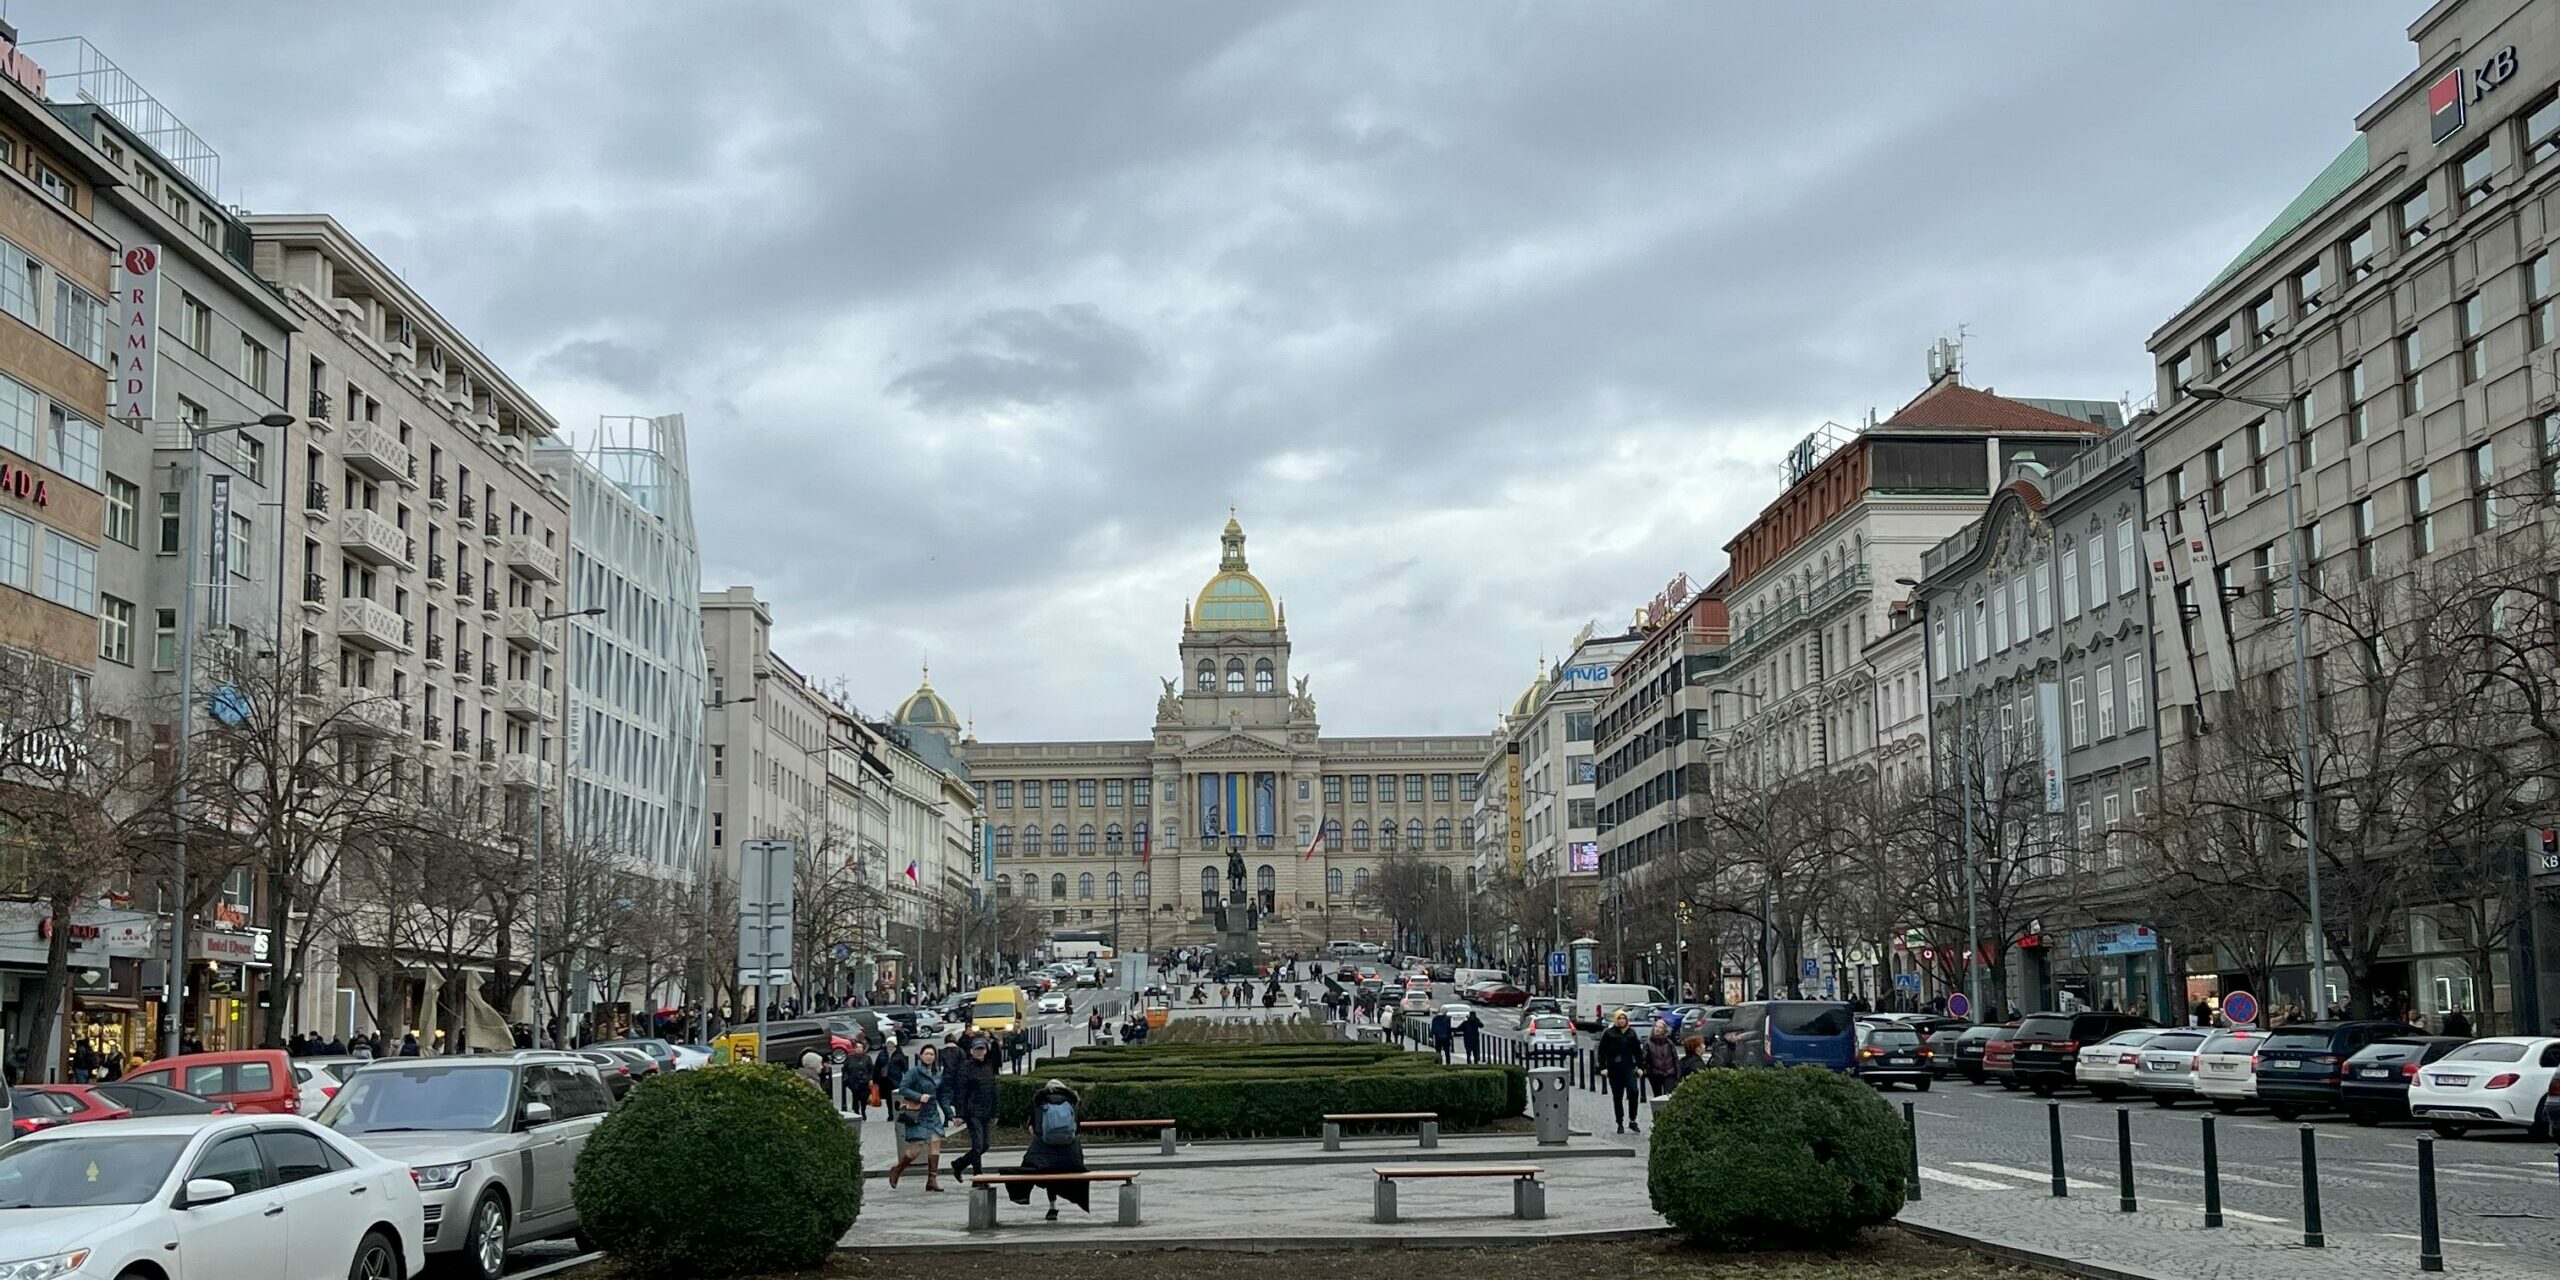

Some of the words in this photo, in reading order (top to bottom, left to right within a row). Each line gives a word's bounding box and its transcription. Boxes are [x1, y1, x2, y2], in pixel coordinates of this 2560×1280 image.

[2473, 46, 2518, 101] KB
[128, 289, 146, 417] RAMADA
[1787, 432, 1815, 488] SZIF
[2193, 555, 2208, 563] KB
[1565, 666, 1609, 682] invia
[571, 700, 579, 750] PRIMARK
[1510, 816, 1520, 867] MODY
[2541, 855, 2559, 868] KB
